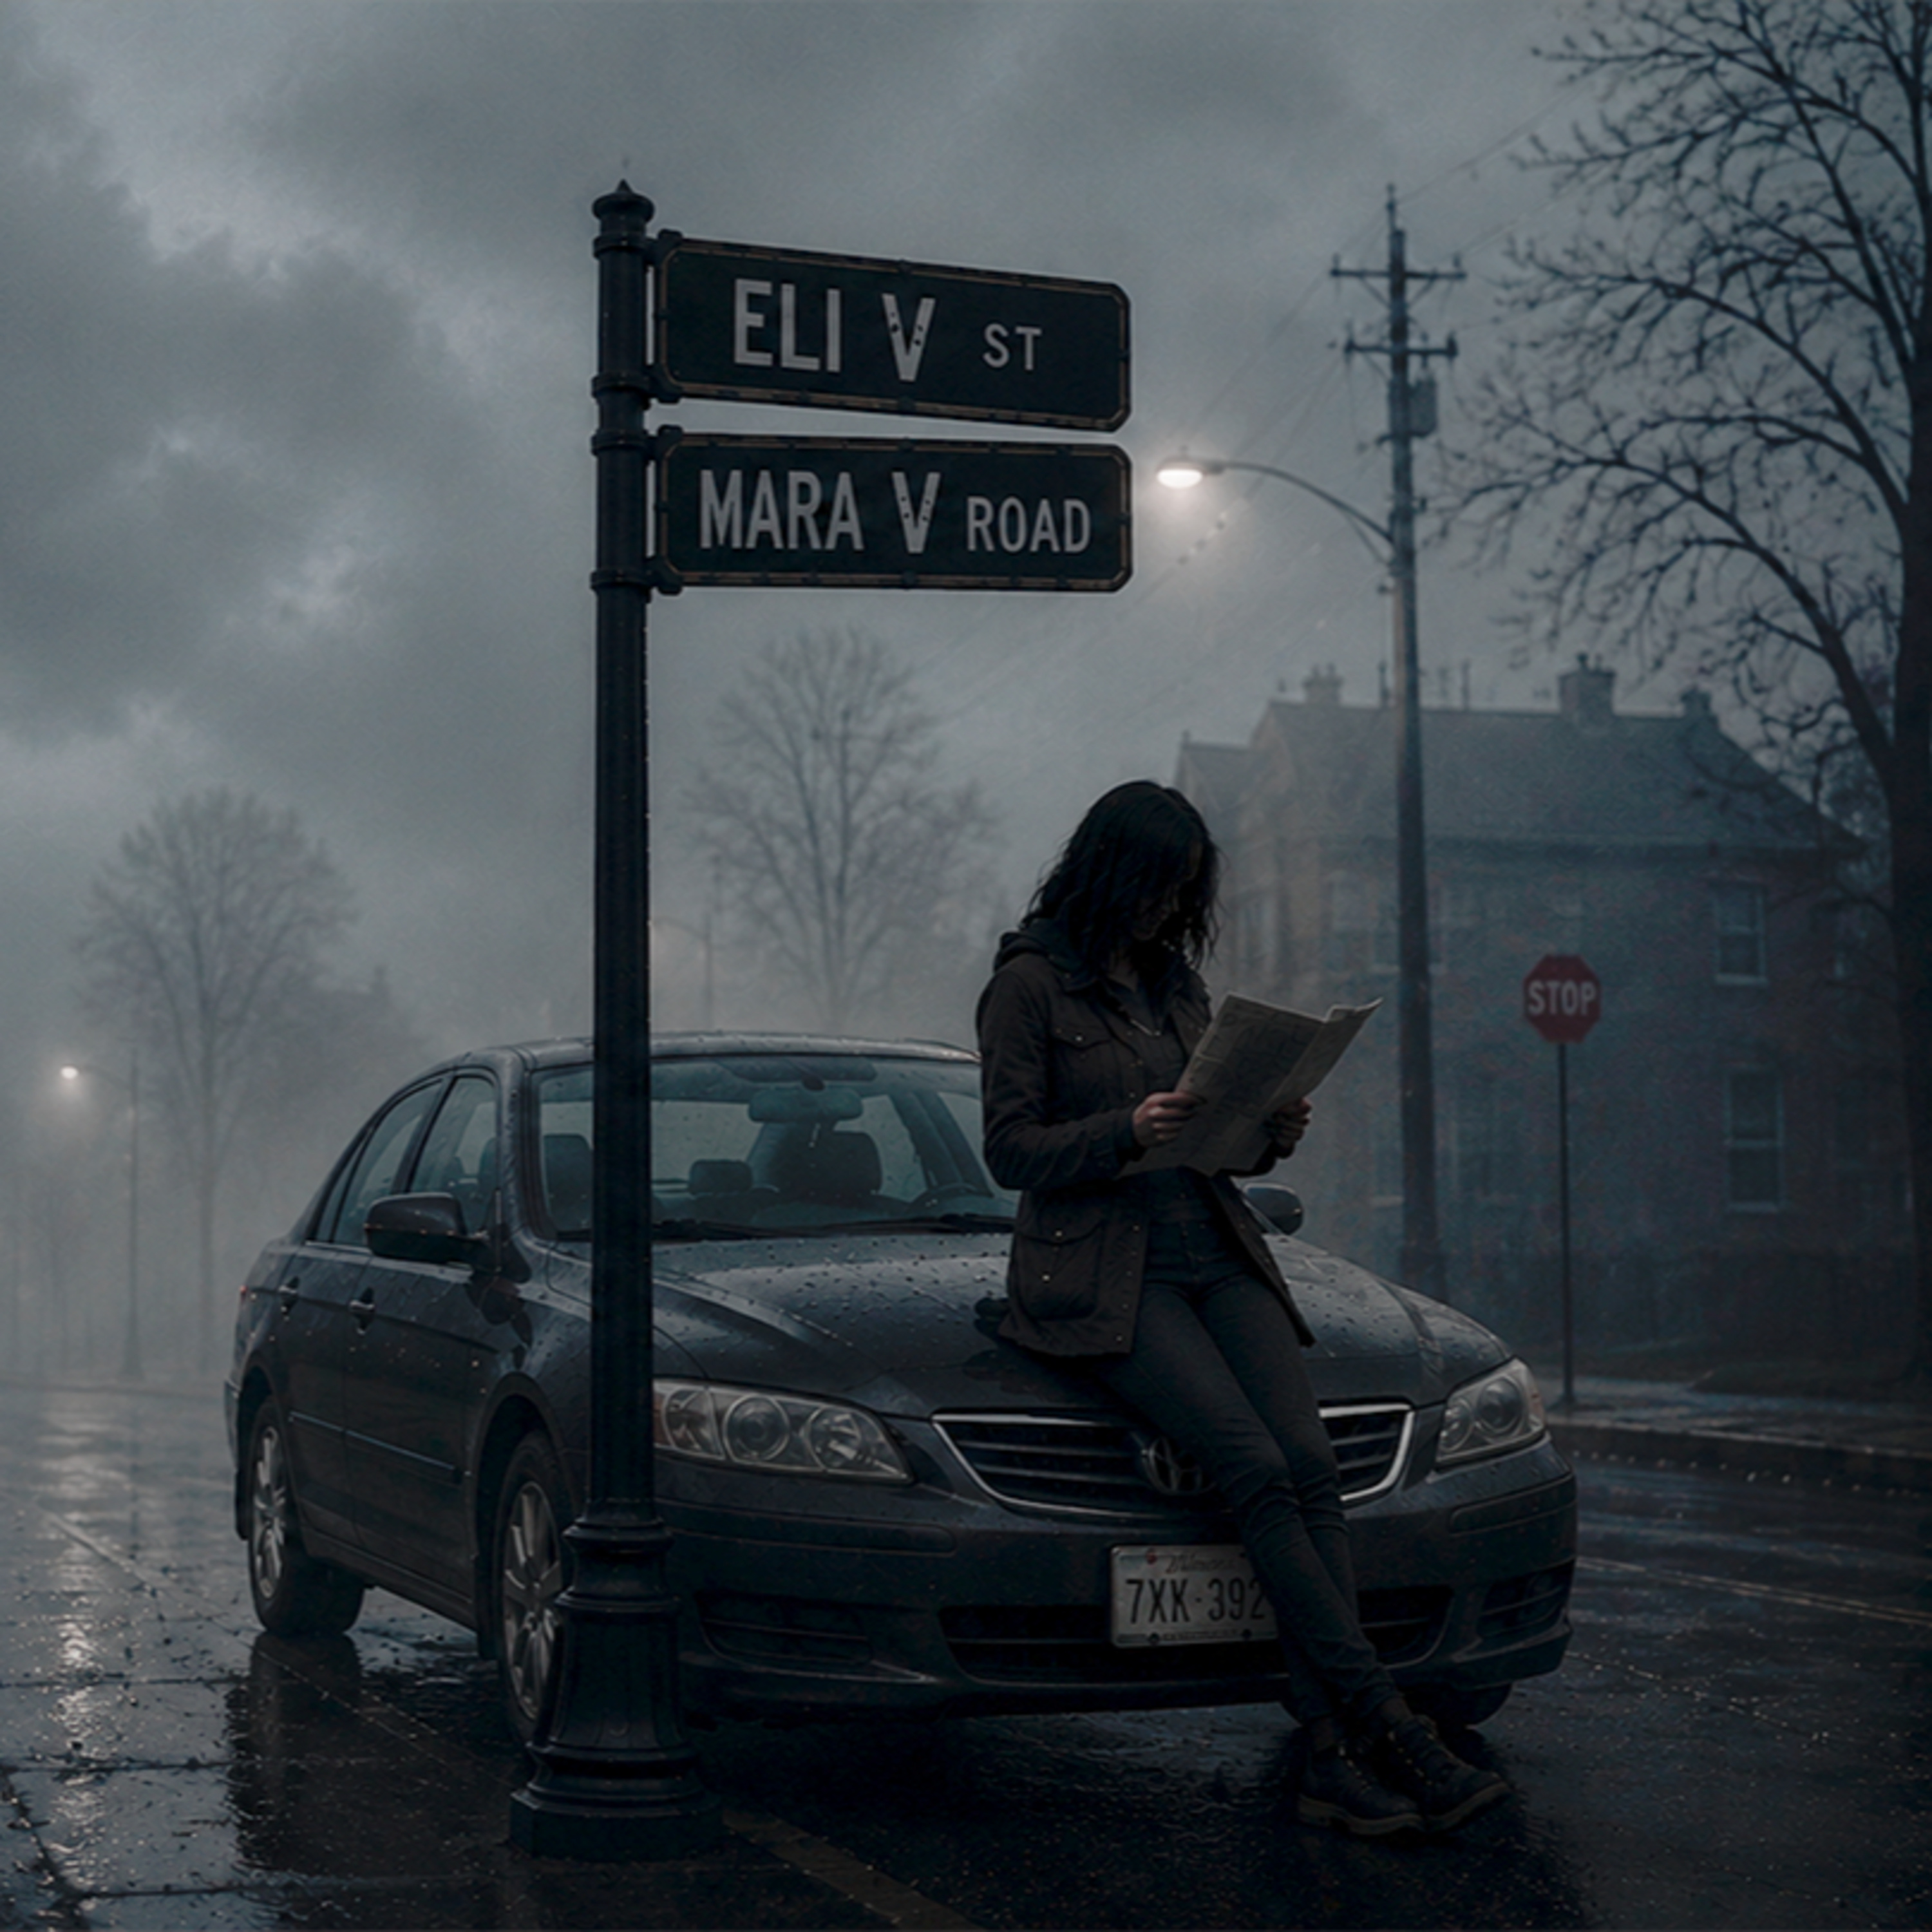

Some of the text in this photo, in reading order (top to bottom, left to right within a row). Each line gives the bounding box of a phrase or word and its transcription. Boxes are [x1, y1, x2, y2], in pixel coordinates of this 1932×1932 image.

[735, 279, 1041, 381] ELI V ST
[701, 470, 1090, 553] MARA V ROAD
[1529, 980, 1596, 1016] STOP
